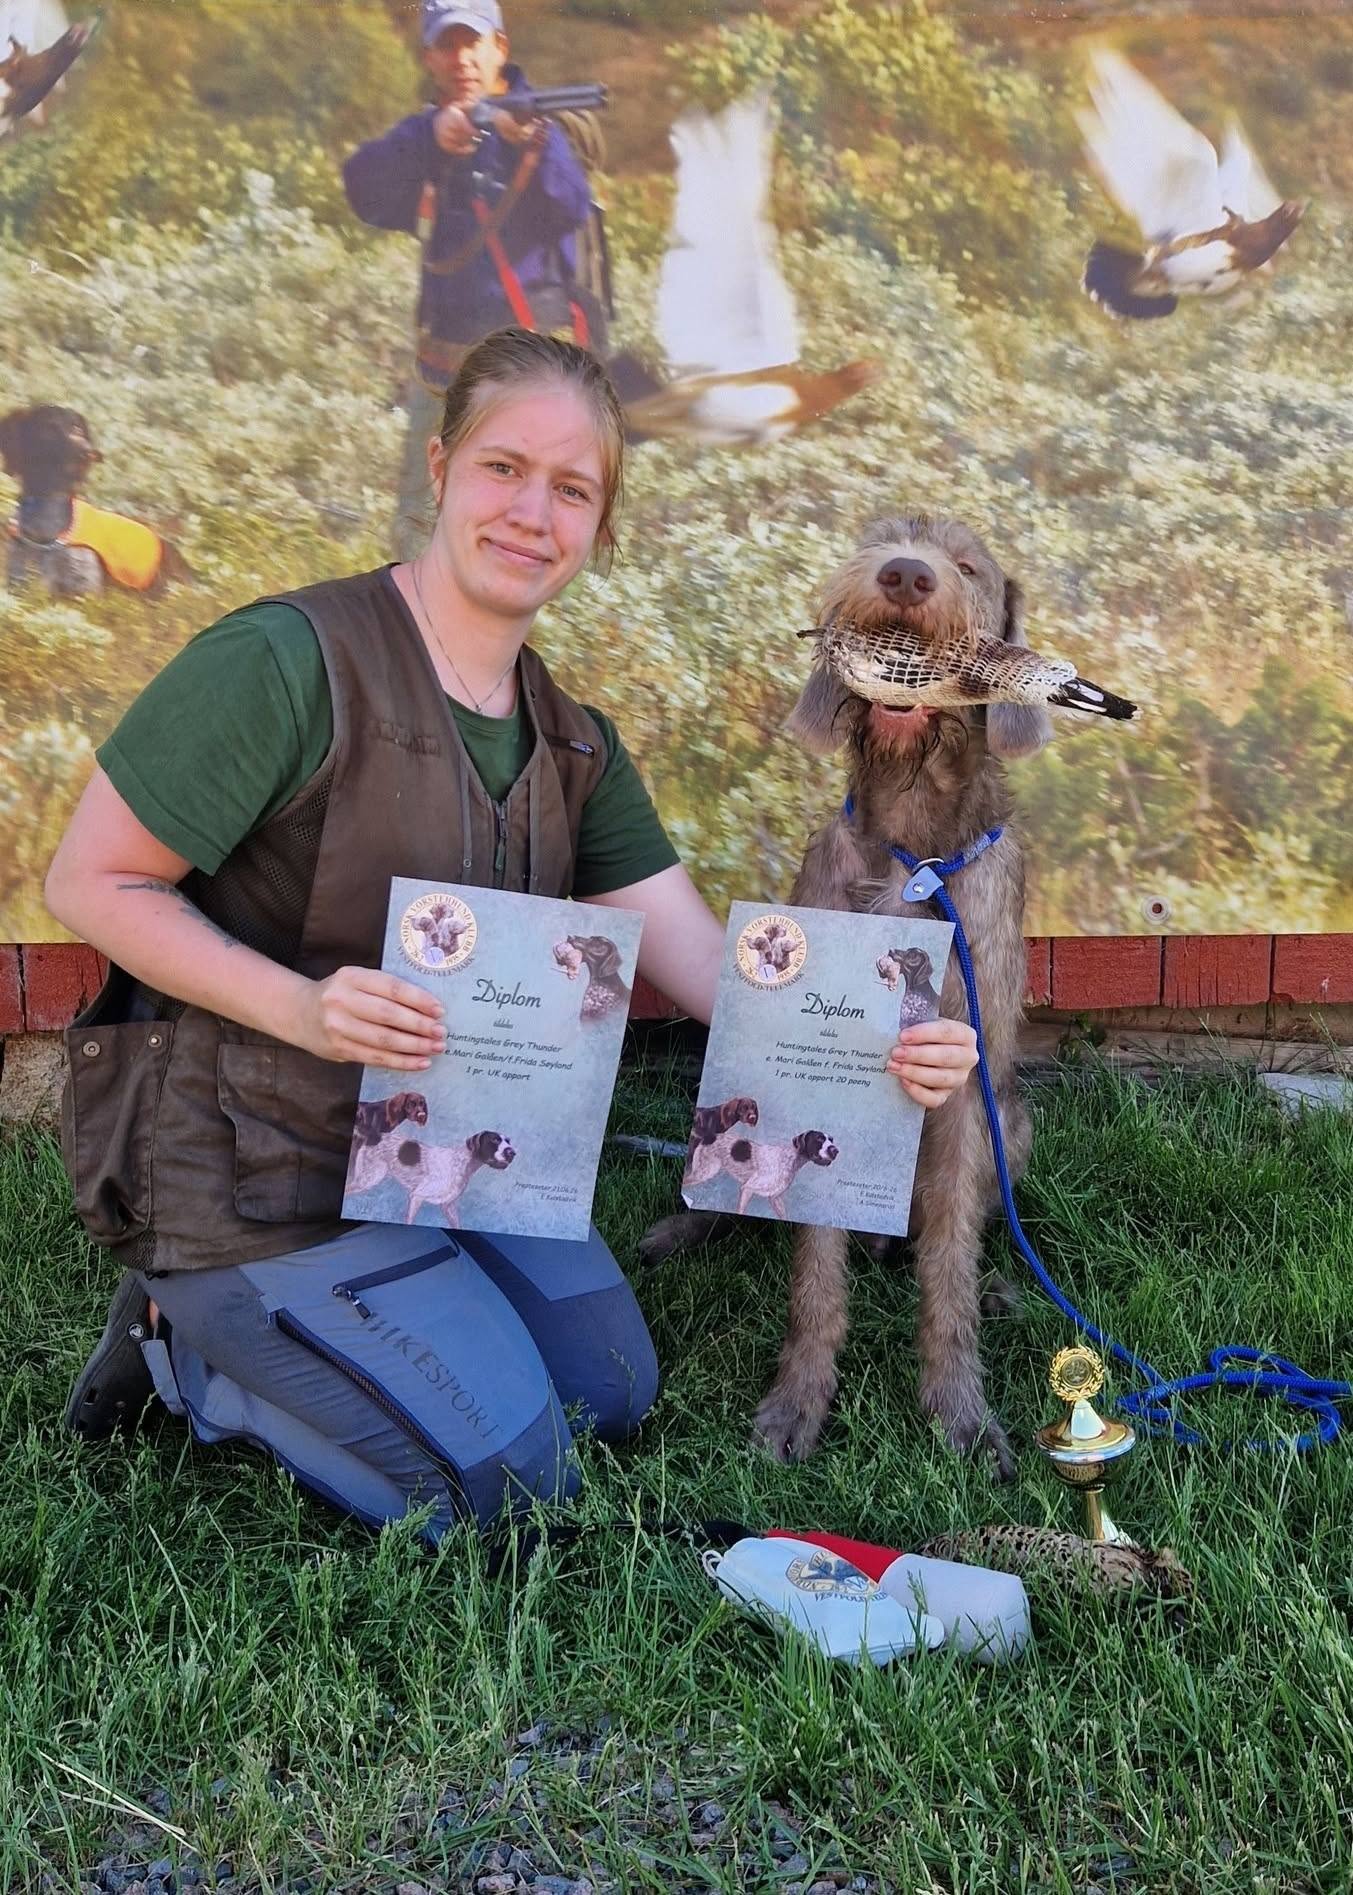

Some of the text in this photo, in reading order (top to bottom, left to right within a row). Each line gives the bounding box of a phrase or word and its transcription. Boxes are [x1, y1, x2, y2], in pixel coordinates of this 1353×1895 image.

[472, 978, 542, 1009] Diplom
[800, 992, 865, 1021] Diplom
[447, 1032, 562, 1053] Huntingtales Grey Thunder
[776, 1041, 883, 1059] Huntingtales Grey Thunder
[488, 1069, 501, 1077] UK
[502, 1072, 531, 1081] apport
[832, 1062, 854, 1070] Frida
[781, 1071, 792, 1079] pr.
[808, 1074, 834, 1082] apport
[848, 1078, 871, 1087] poeng
